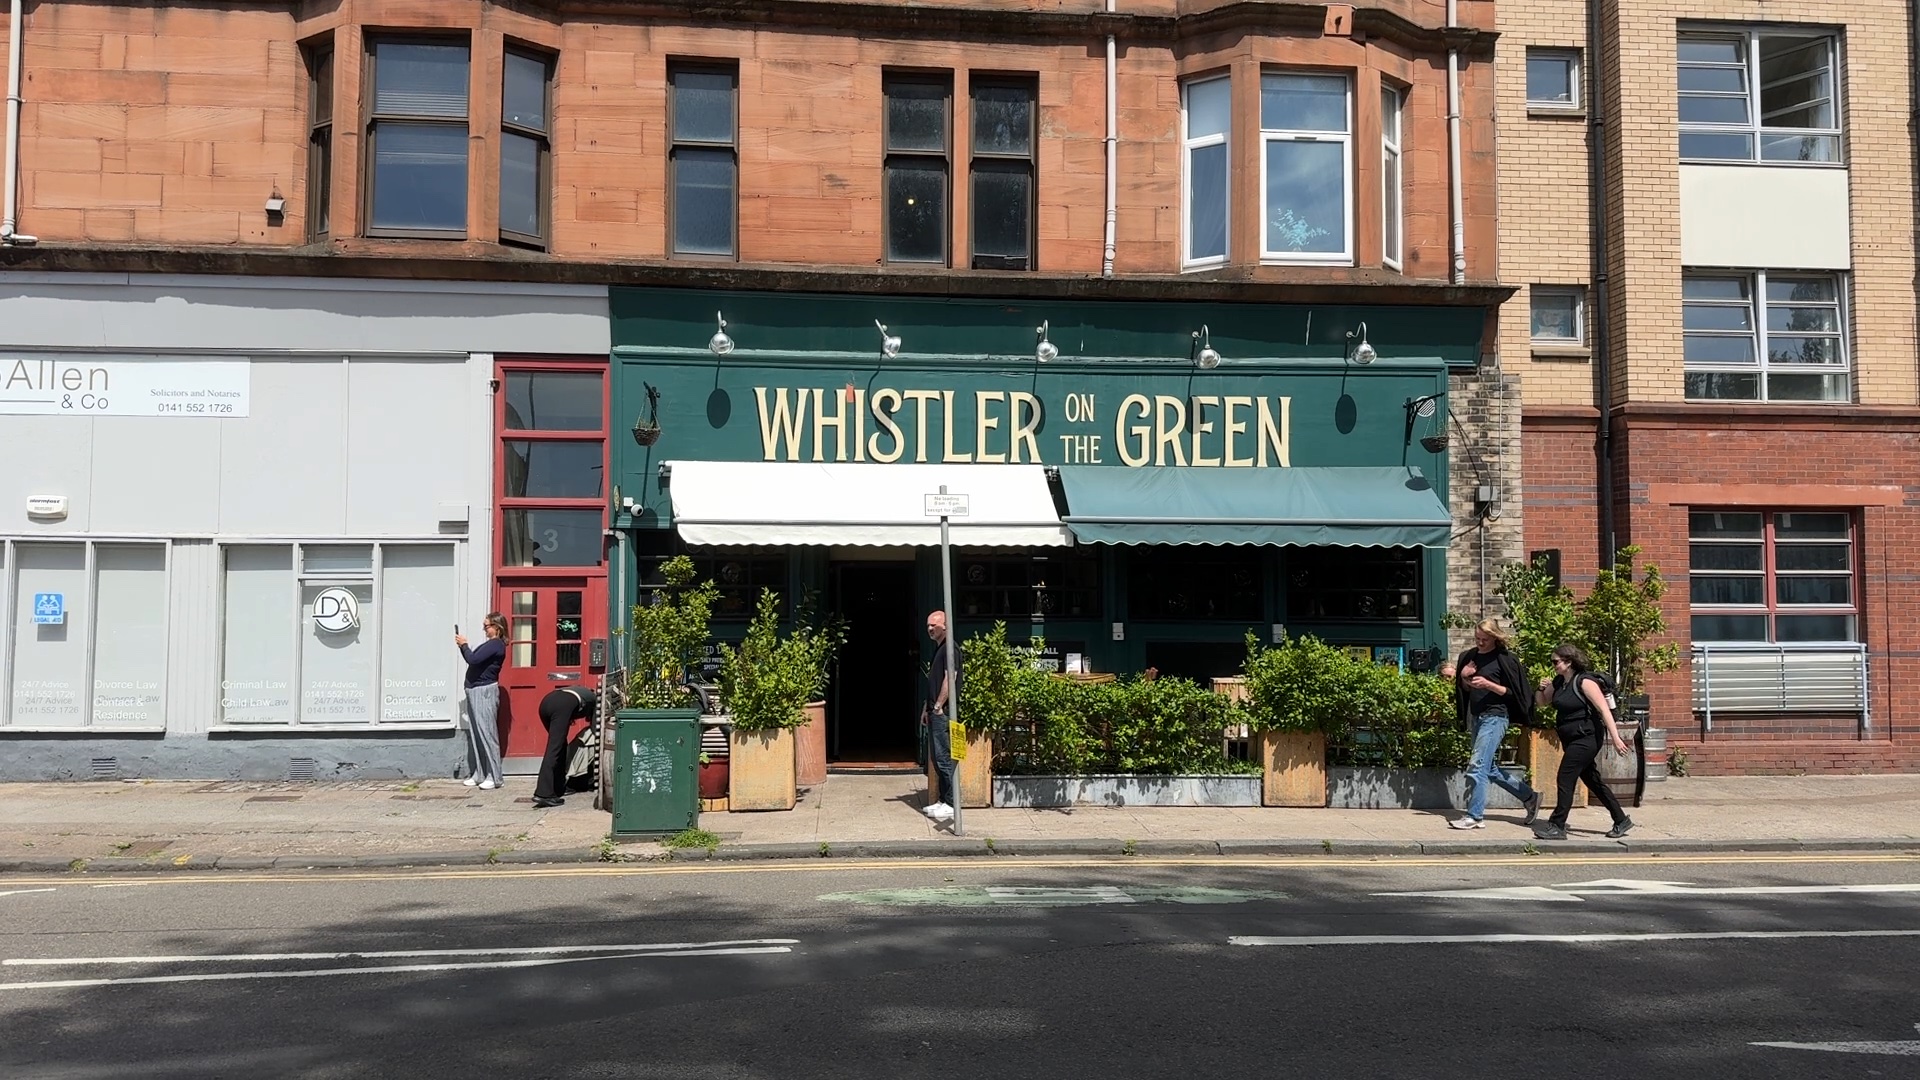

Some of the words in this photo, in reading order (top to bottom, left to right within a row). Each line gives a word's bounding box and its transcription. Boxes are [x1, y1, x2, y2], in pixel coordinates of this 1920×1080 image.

[0, 360, 109, 391] Allen
[150, 389, 188, 397] Solicitors
[190, 389, 205, 397] and
[207, 389, 241, 398] Notaries
[61, 394, 73, 409] &
[81, 393, 109, 410] Co
[158, 403, 182, 412] 0141
[186, 403, 205, 412] 552
[208, 403, 233, 413] 1726
[753, 387, 1043, 464] WHISTLER
[1065, 393, 1094, 422] ON
[1059, 435, 1102, 464] THE
[1115, 394, 1292, 467] GREEN
[542, 528, 559, 553] 3
[1043, 647, 1059, 655] ALL
[22, 680, 40, 688] 24/7
[41, 680, 69, 688] Advice
[94, 680, 133, 689] Divorce
[136, 680, 158, 689] Law
[222, 680, 262, 690] Criminal
[266, 680, 287, 689] Law
[384, 679, 422, 688] Divorce
[426, 678, 446, 687] Law
[14, 690, 34, 698] 0141
[37, 690, 52, 698] 552
[56, 690, 76, 698] 1726
[304, 690, 324, 698] 0141
[327, 690, 342, 698] 552
[346, 690, 364, 698] 1726
[94, 697, 133, 707] Contact
[136, 698, 144, 706] &
[222, 698, 246, 707] Child
[250, 698, 271, 706] Law
[384, 696, 422, 705] Contact
[94, 710, 147, 720] Residence
[384, 708, 436, 718] Residence
